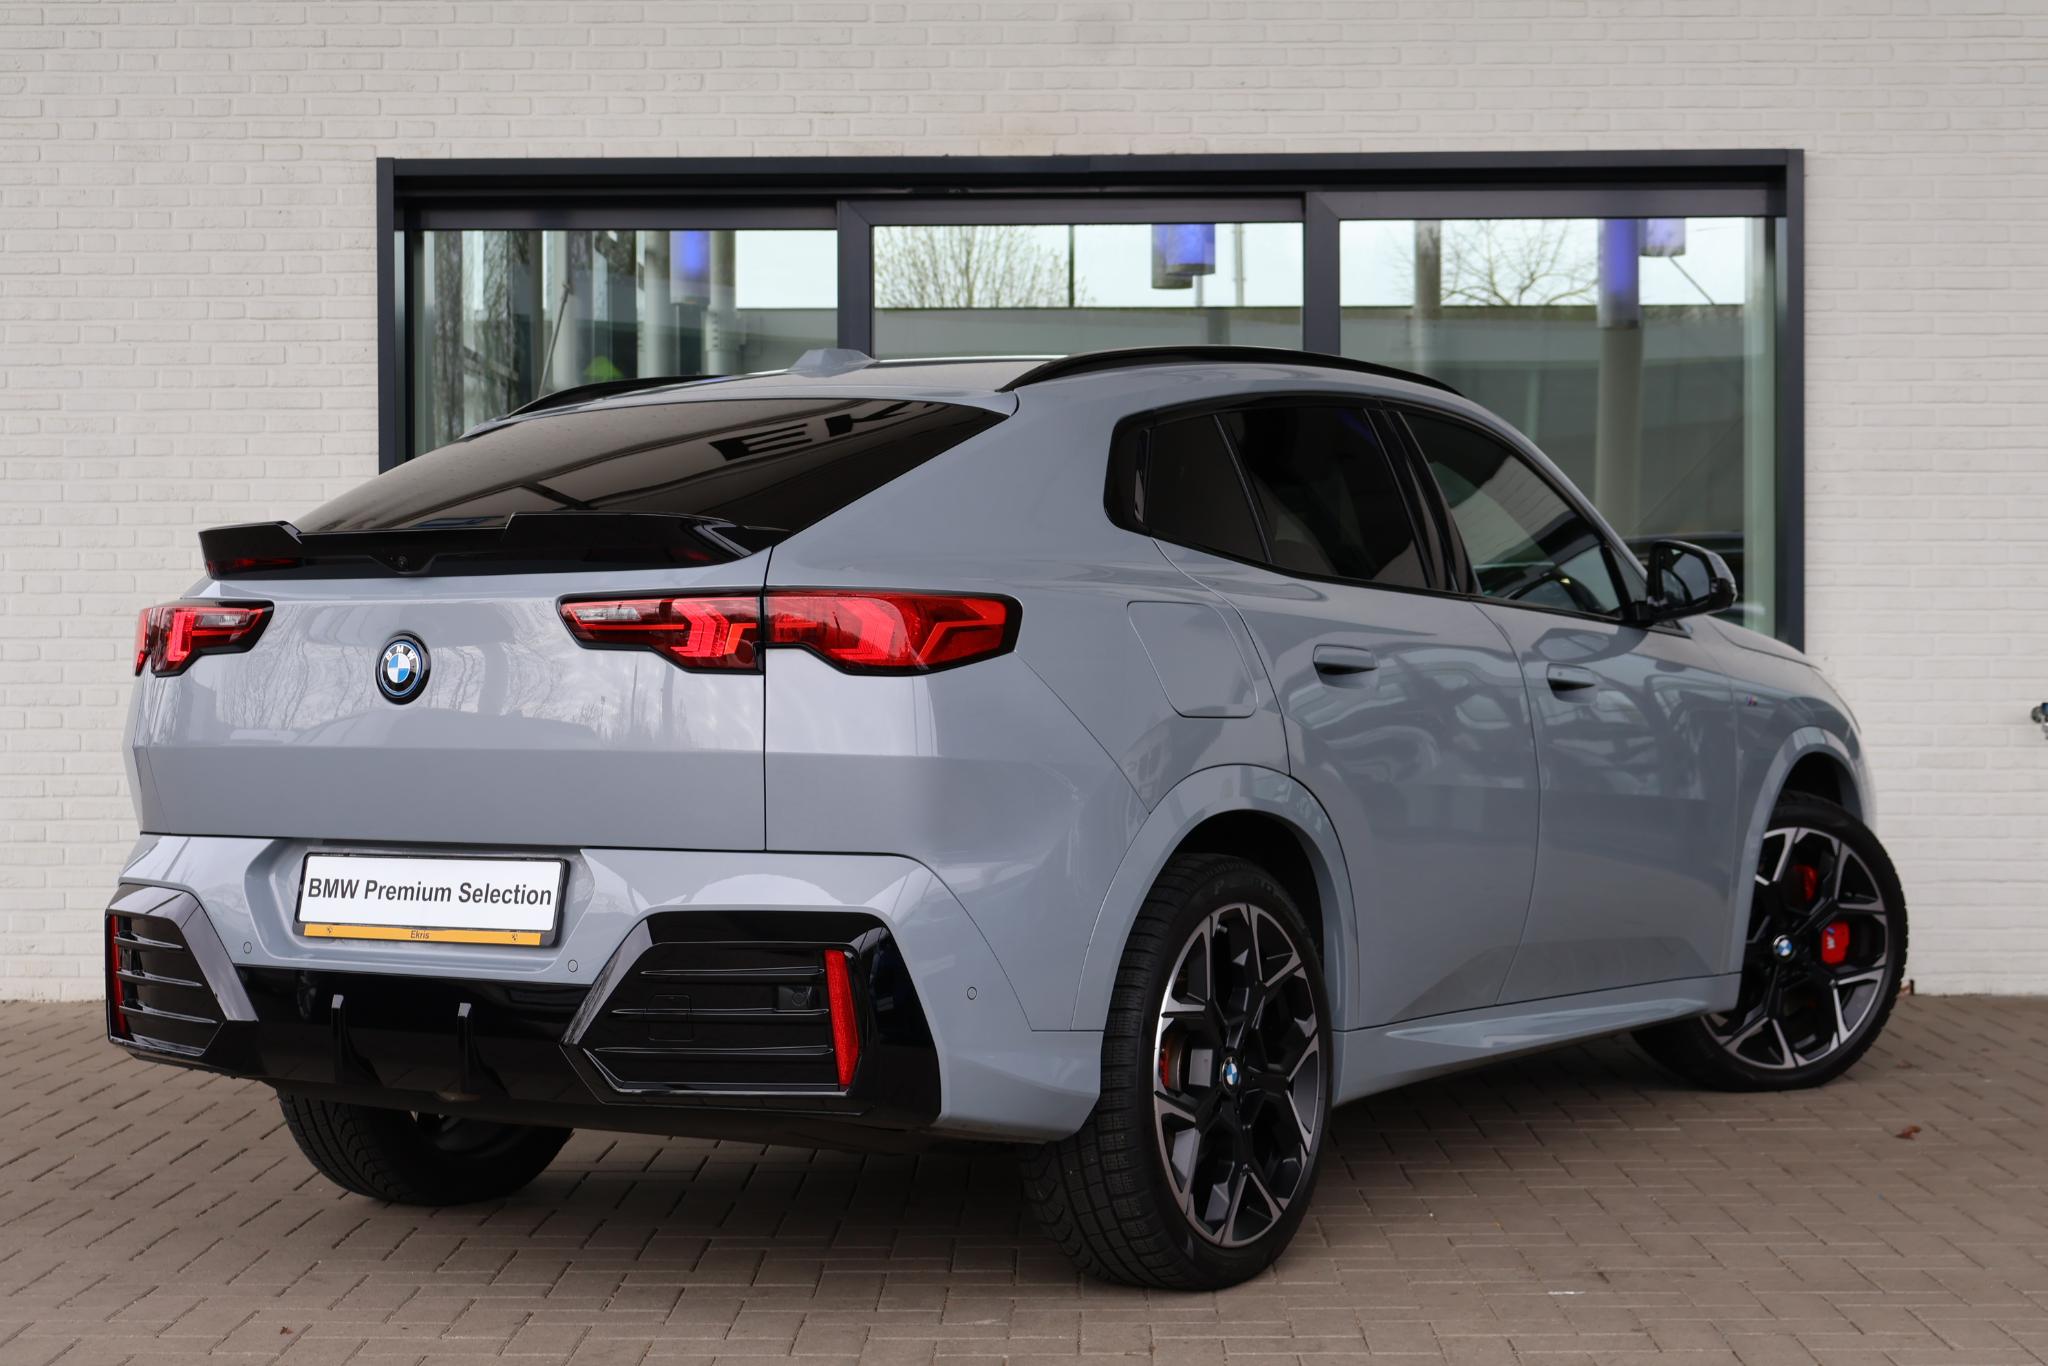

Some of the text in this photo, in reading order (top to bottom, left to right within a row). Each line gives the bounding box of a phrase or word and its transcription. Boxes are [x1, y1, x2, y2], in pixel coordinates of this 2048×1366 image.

[385, 645, 416, 661] BMW
[307, 877, 552, 905] BMW Premium Selection
[409, 930, 430, 940] Ekris
